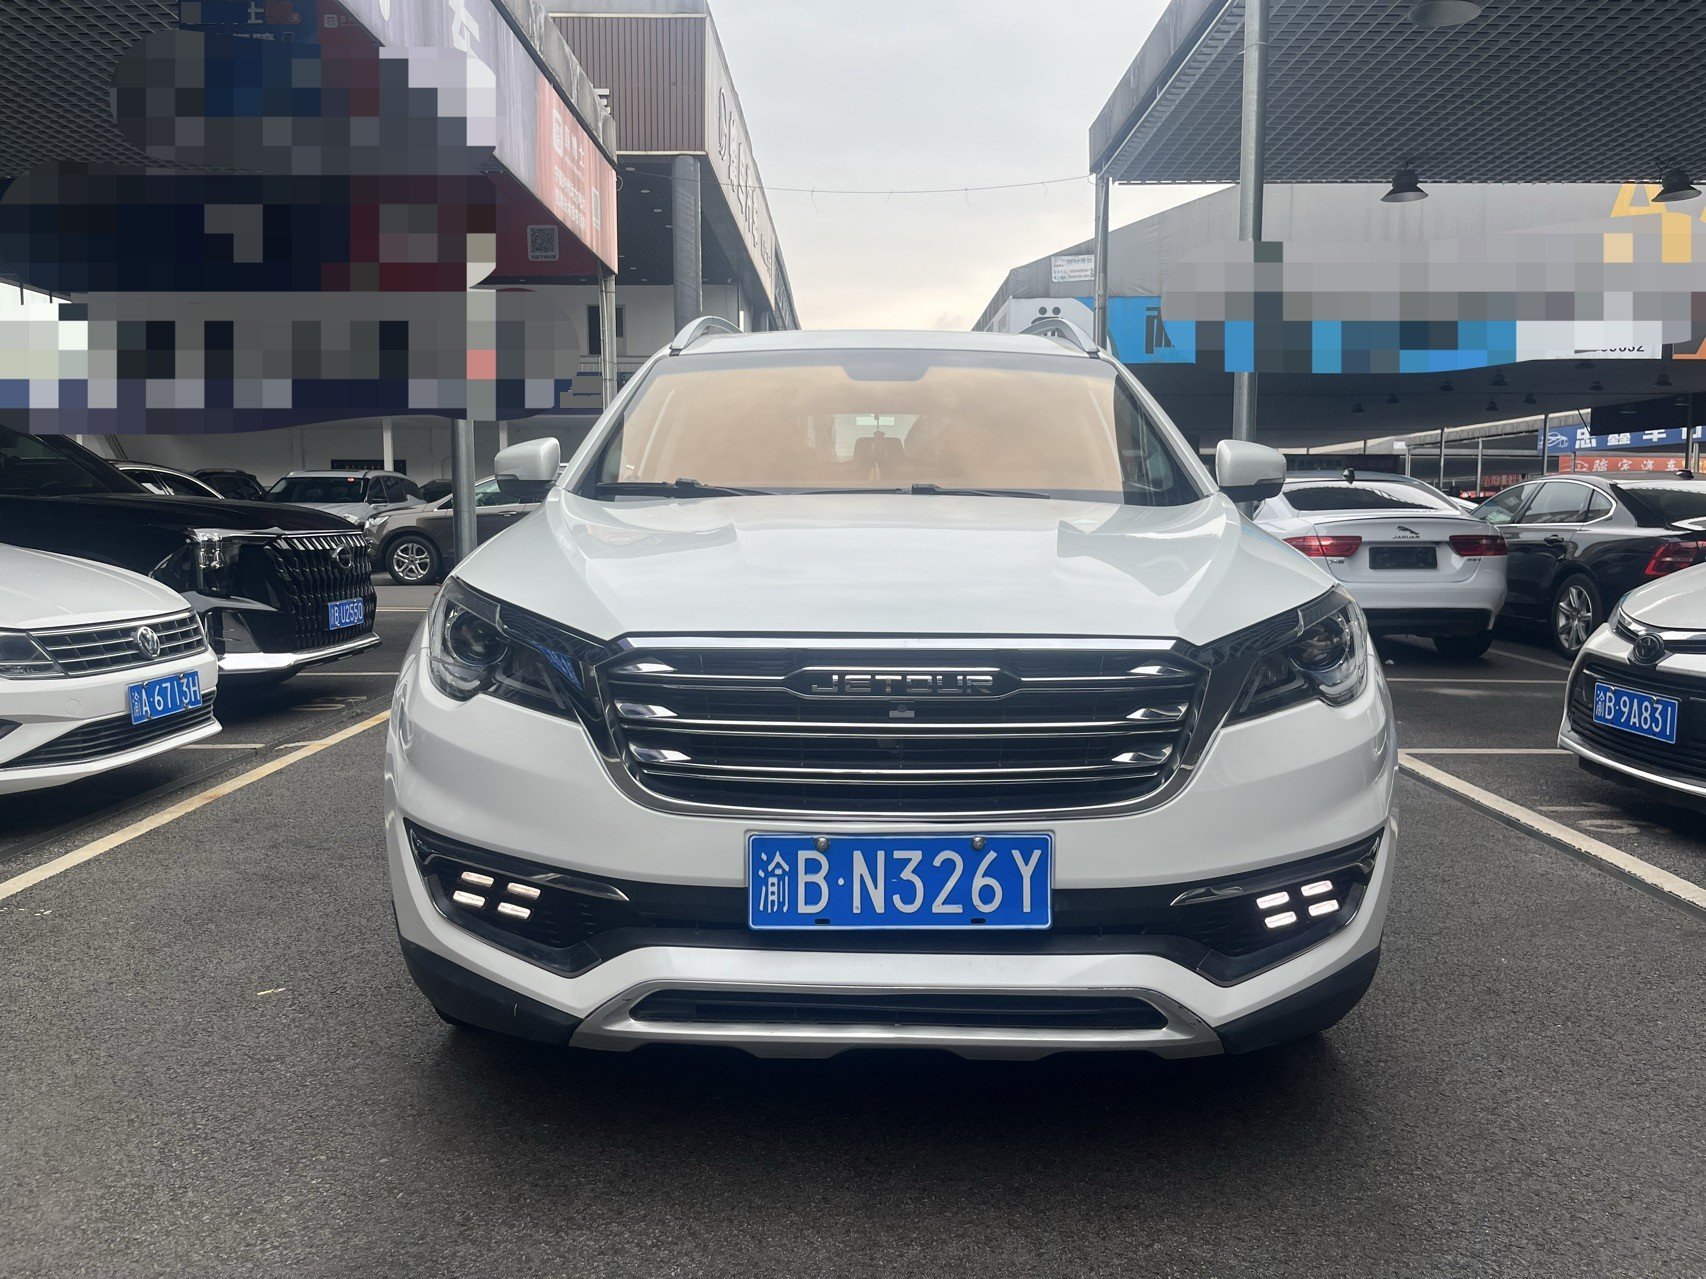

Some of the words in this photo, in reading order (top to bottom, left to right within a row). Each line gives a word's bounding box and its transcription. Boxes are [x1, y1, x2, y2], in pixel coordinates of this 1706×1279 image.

[329, 602, 364, 626] B·U2550
[811, 674, 994, 694] JETOUR
[1595, 690, 1672, 736] 渝B·9A831
[758, 849, 1042, 914] 渝B·N326Y
